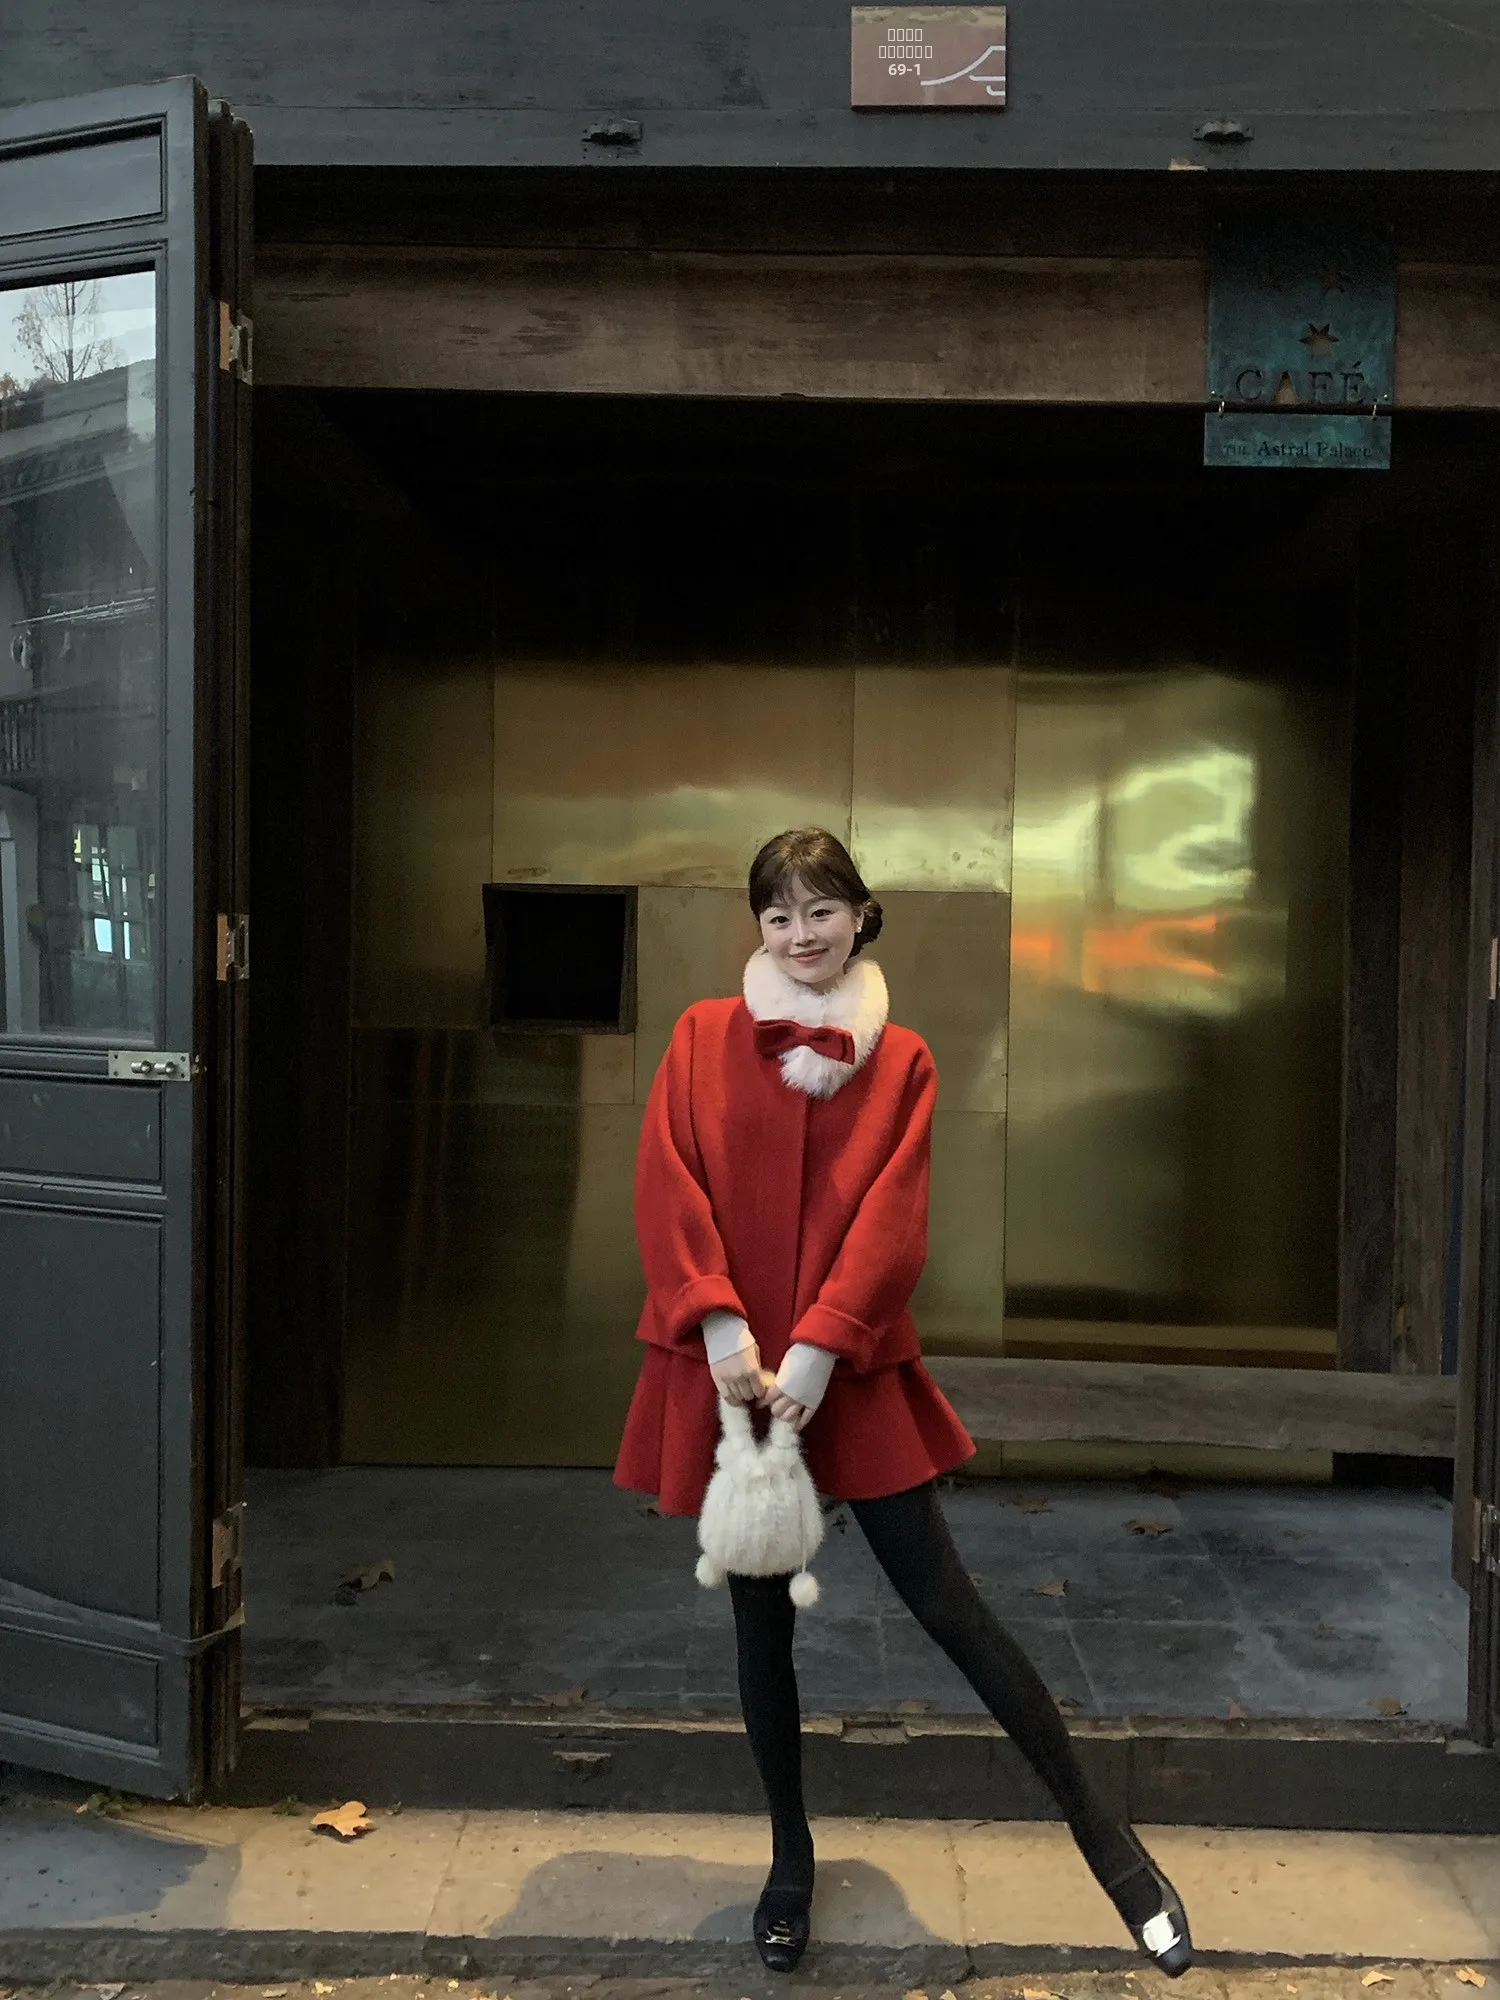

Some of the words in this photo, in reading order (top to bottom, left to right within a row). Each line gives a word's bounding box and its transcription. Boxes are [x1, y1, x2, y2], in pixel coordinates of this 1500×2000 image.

[888, 63, 921, 76] 69-1
[1235, 360, 1366, 404] CAFÉ
[1257, 441, 1309, 457] Astral
[1315, 441, 1372, 458] Palace
